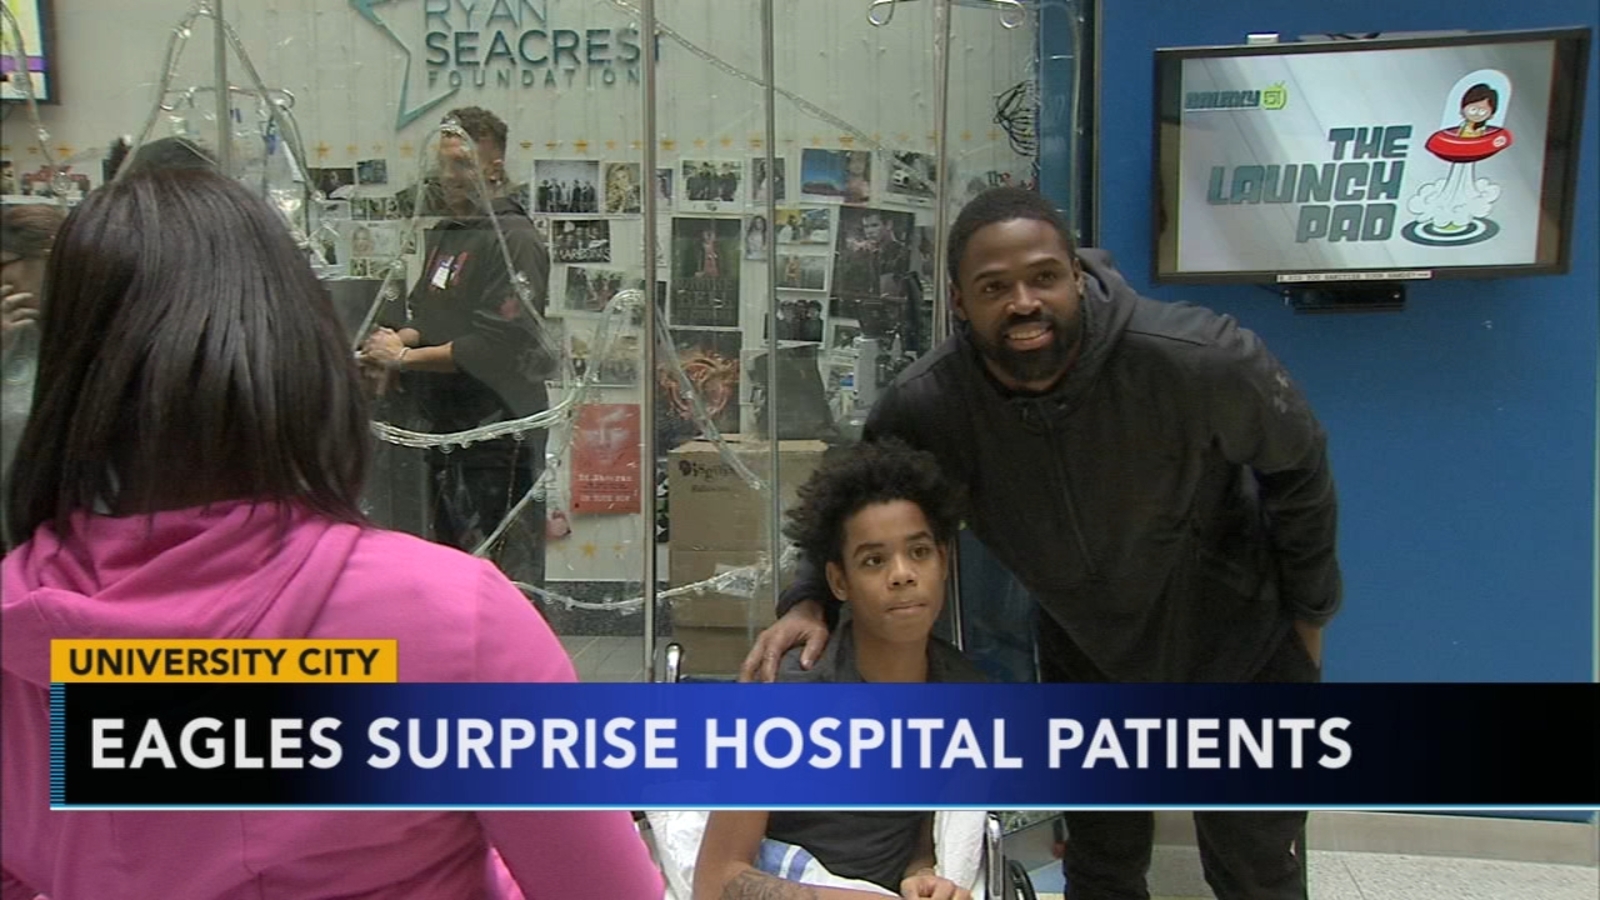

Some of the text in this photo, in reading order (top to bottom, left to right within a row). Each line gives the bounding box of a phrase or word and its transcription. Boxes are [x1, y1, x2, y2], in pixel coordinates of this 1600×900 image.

[424, 0, 547, 29] RYAN
[425, 29, 662, 66] SEACREST
[428, 68, 641, 88] FOUNDATION
[1328, 125, 1412, 160] THE
[1206, 160, 1405, 205] LAUNCH
[1295, 203, 1397, 243] PAD
